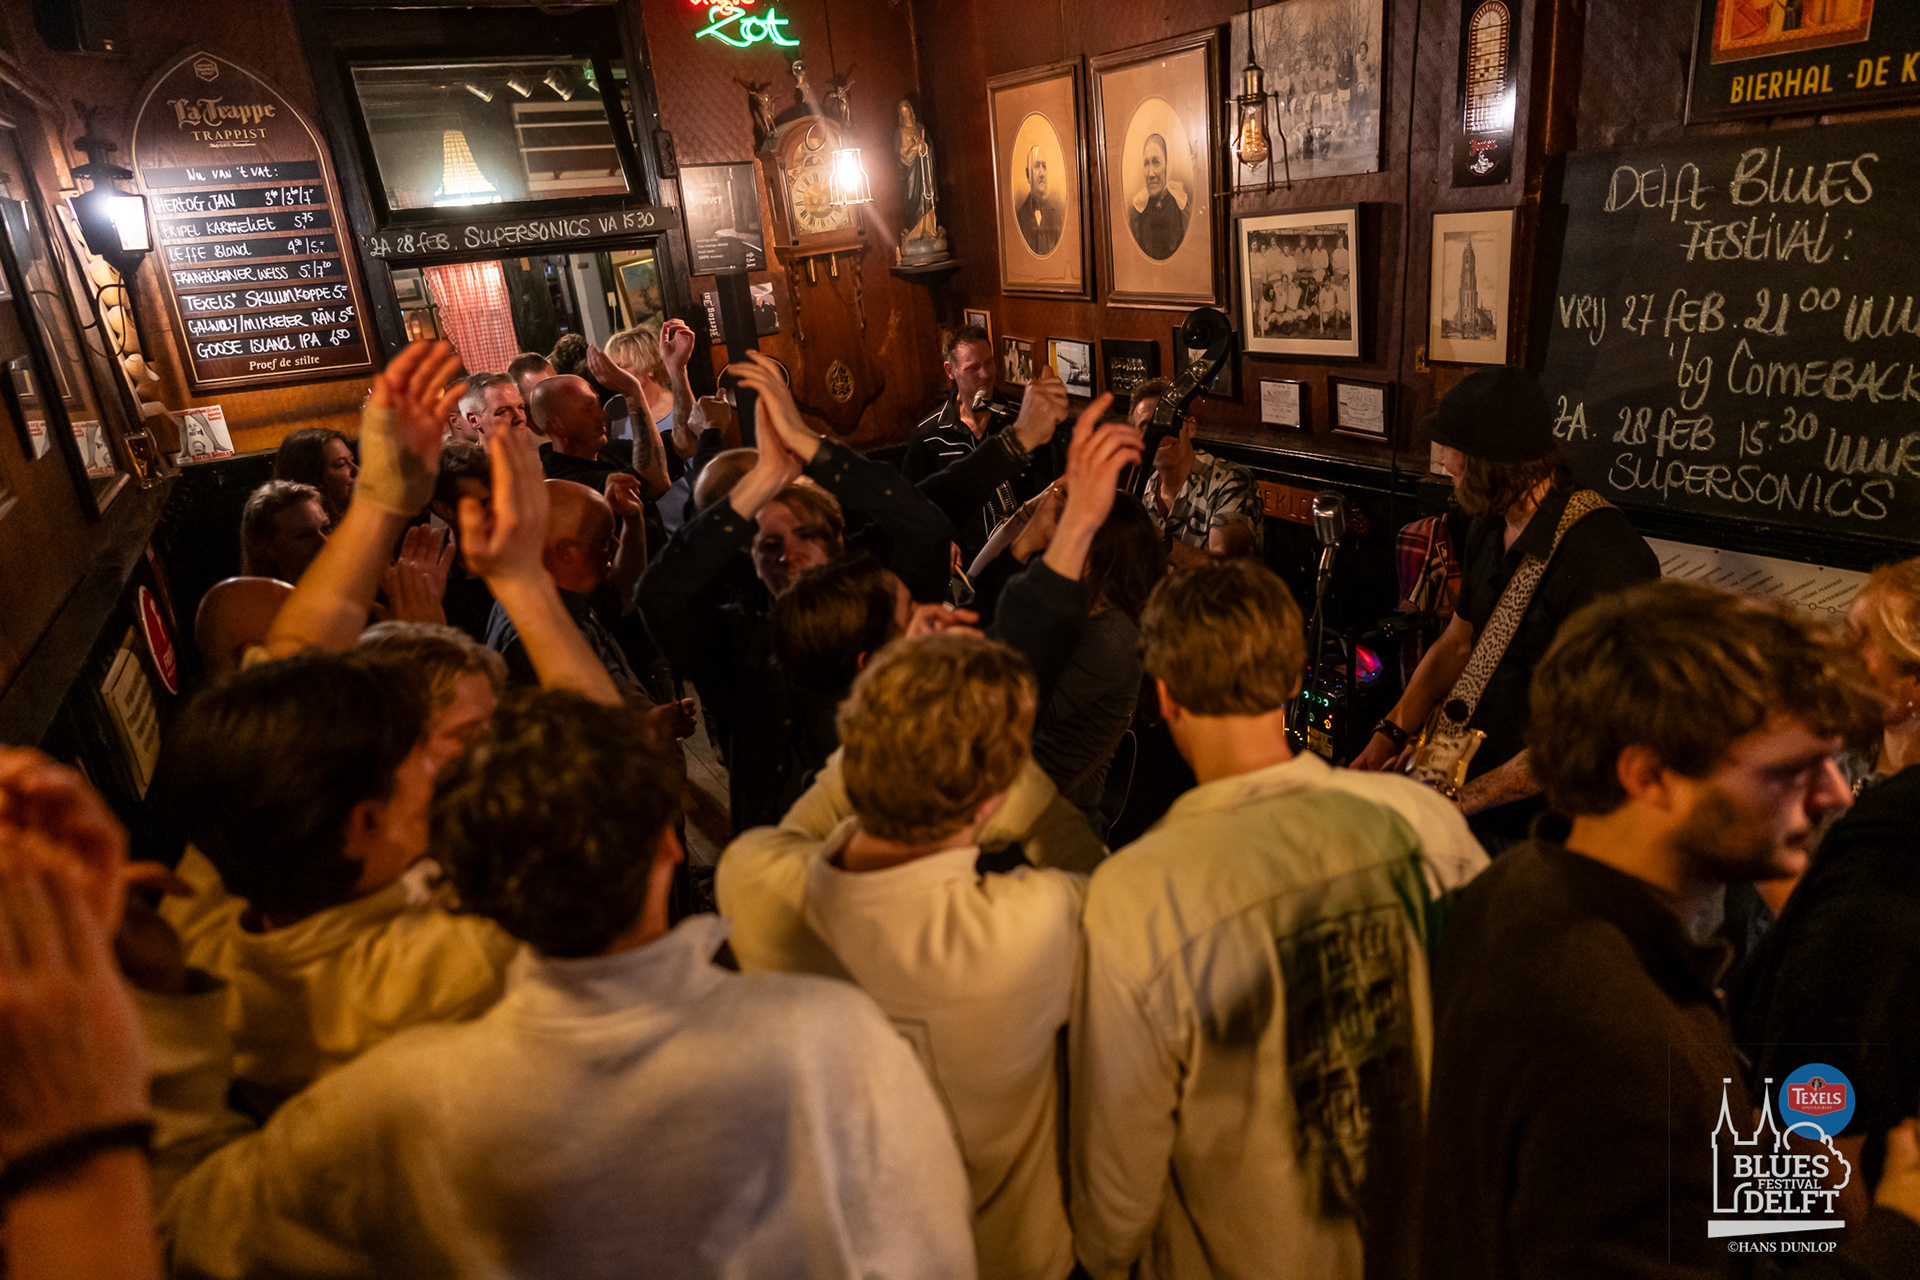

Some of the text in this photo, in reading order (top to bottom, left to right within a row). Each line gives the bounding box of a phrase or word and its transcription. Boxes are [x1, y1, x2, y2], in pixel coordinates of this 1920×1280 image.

[696, 6, 800, 47] Zot
[1730, 64, 1833, 104] BIERHAL
[197, 96, 276, 127] Trappe
[190, 128, 267, 141] TRAPPIST
[207, 192, 236, 211] JAN
[463, 217, 591, 249] SUPERSONICS
[598, 218, 618, 234] VA
[257, 266, 289, 280] WEISS
[707, 307, 721, 338] Hertog
[1621, 294, 1654, 336] 27
[196, 340, 243, 359] GOOSE
[299, 332, 322, 349] IPA
[249, 355, 320, 371] Proef de stilte
[1613, 406, 1653, 445] 28
[1608, 452, 1895, 521] SUPERSONICS
